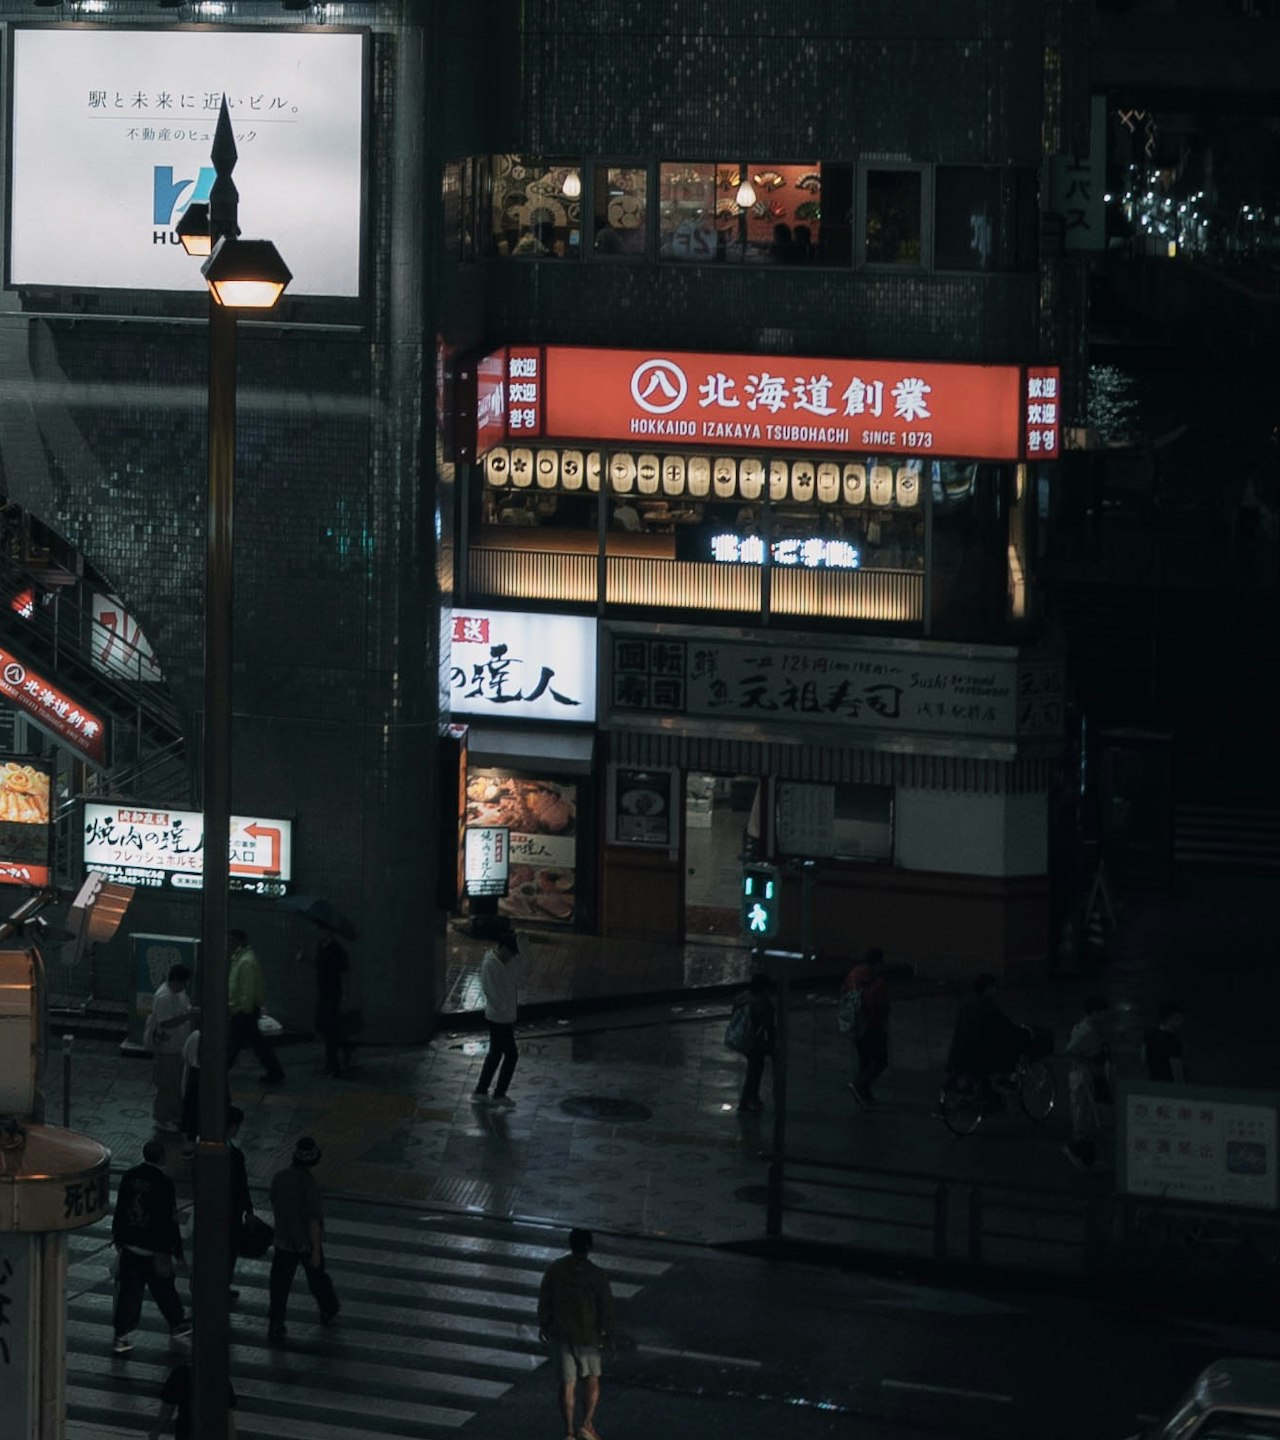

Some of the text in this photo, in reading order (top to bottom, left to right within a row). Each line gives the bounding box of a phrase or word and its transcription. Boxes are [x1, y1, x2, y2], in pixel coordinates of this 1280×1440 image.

[87, 90, 299, 115] 駅と未来に近いビル。
[126, 126, 257, 142] 不動産のヒュック
[697, 373, 932, 422] 北海道創業
[630, 417, 933, 448] HOKKAIDO IZAKAYA TSUBOHACHI SINCE 1973
[23, 679, 99, 738] 北海道創業
[739, 674, 903, 720] 元祖寿司
